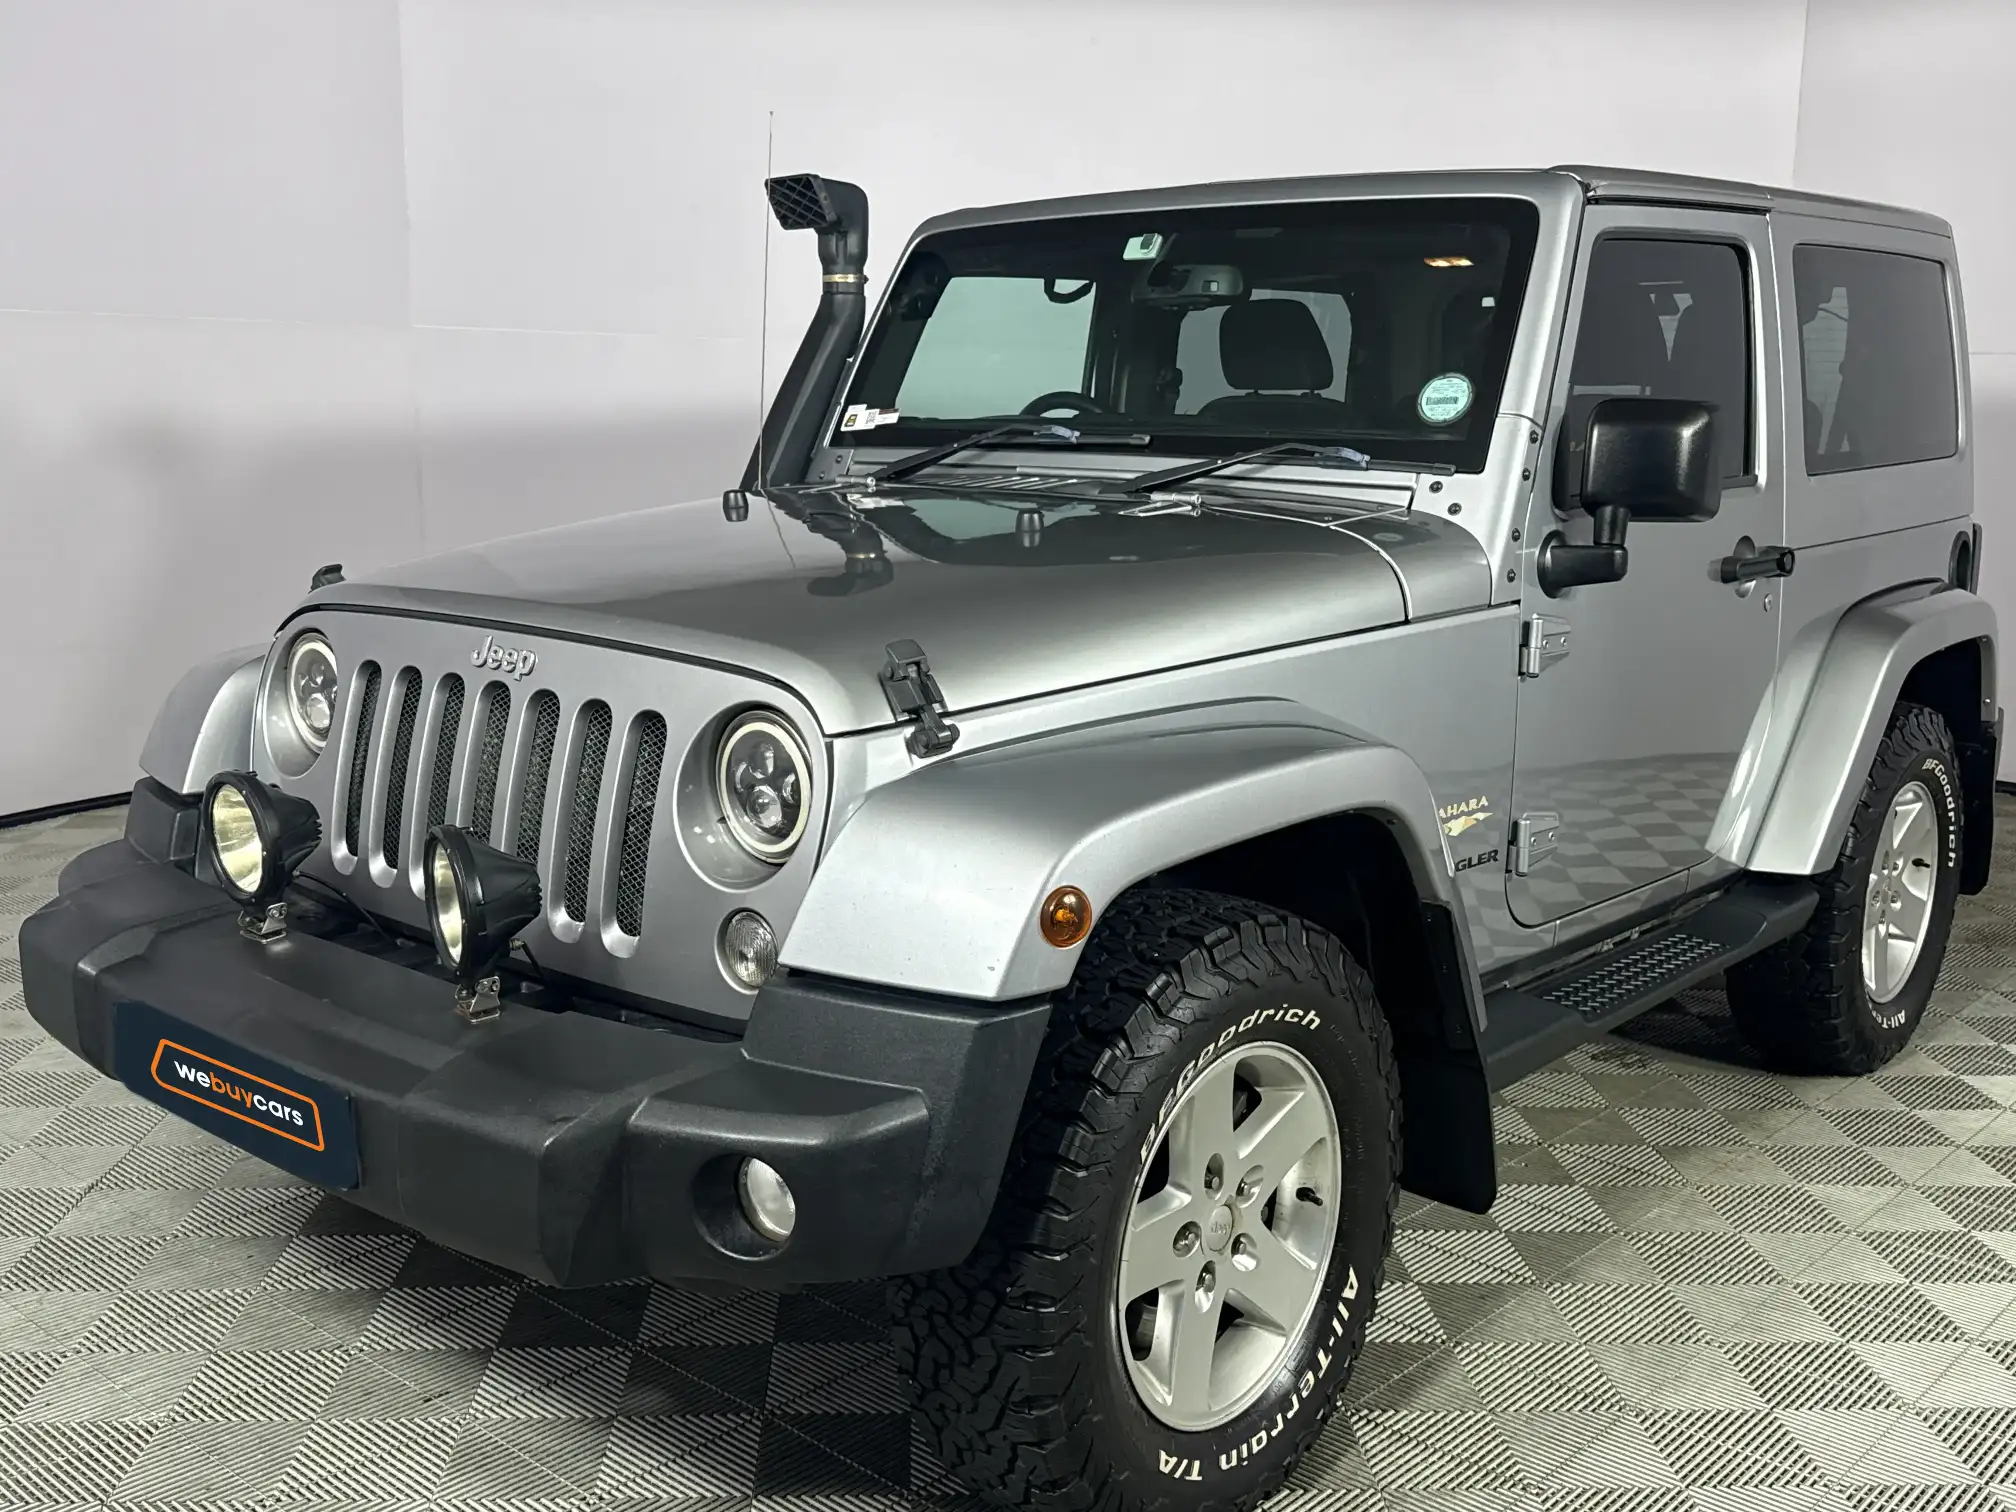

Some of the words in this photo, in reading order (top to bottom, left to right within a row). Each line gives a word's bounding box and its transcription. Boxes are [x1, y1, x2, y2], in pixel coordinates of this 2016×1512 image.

[470, 635, 537, 682] Jeep
[1438, 795, 1489, 819] AHARA
[1922, 758, 1957, 868] BFGoodrich
[1455, 848, 1499, 873] GLER
[174, 1060, 304, 1126] webuycars
[1218, 1263, 1359, 1471] All-Terrain
[1158, 1449, 1203, 1481] T/A
